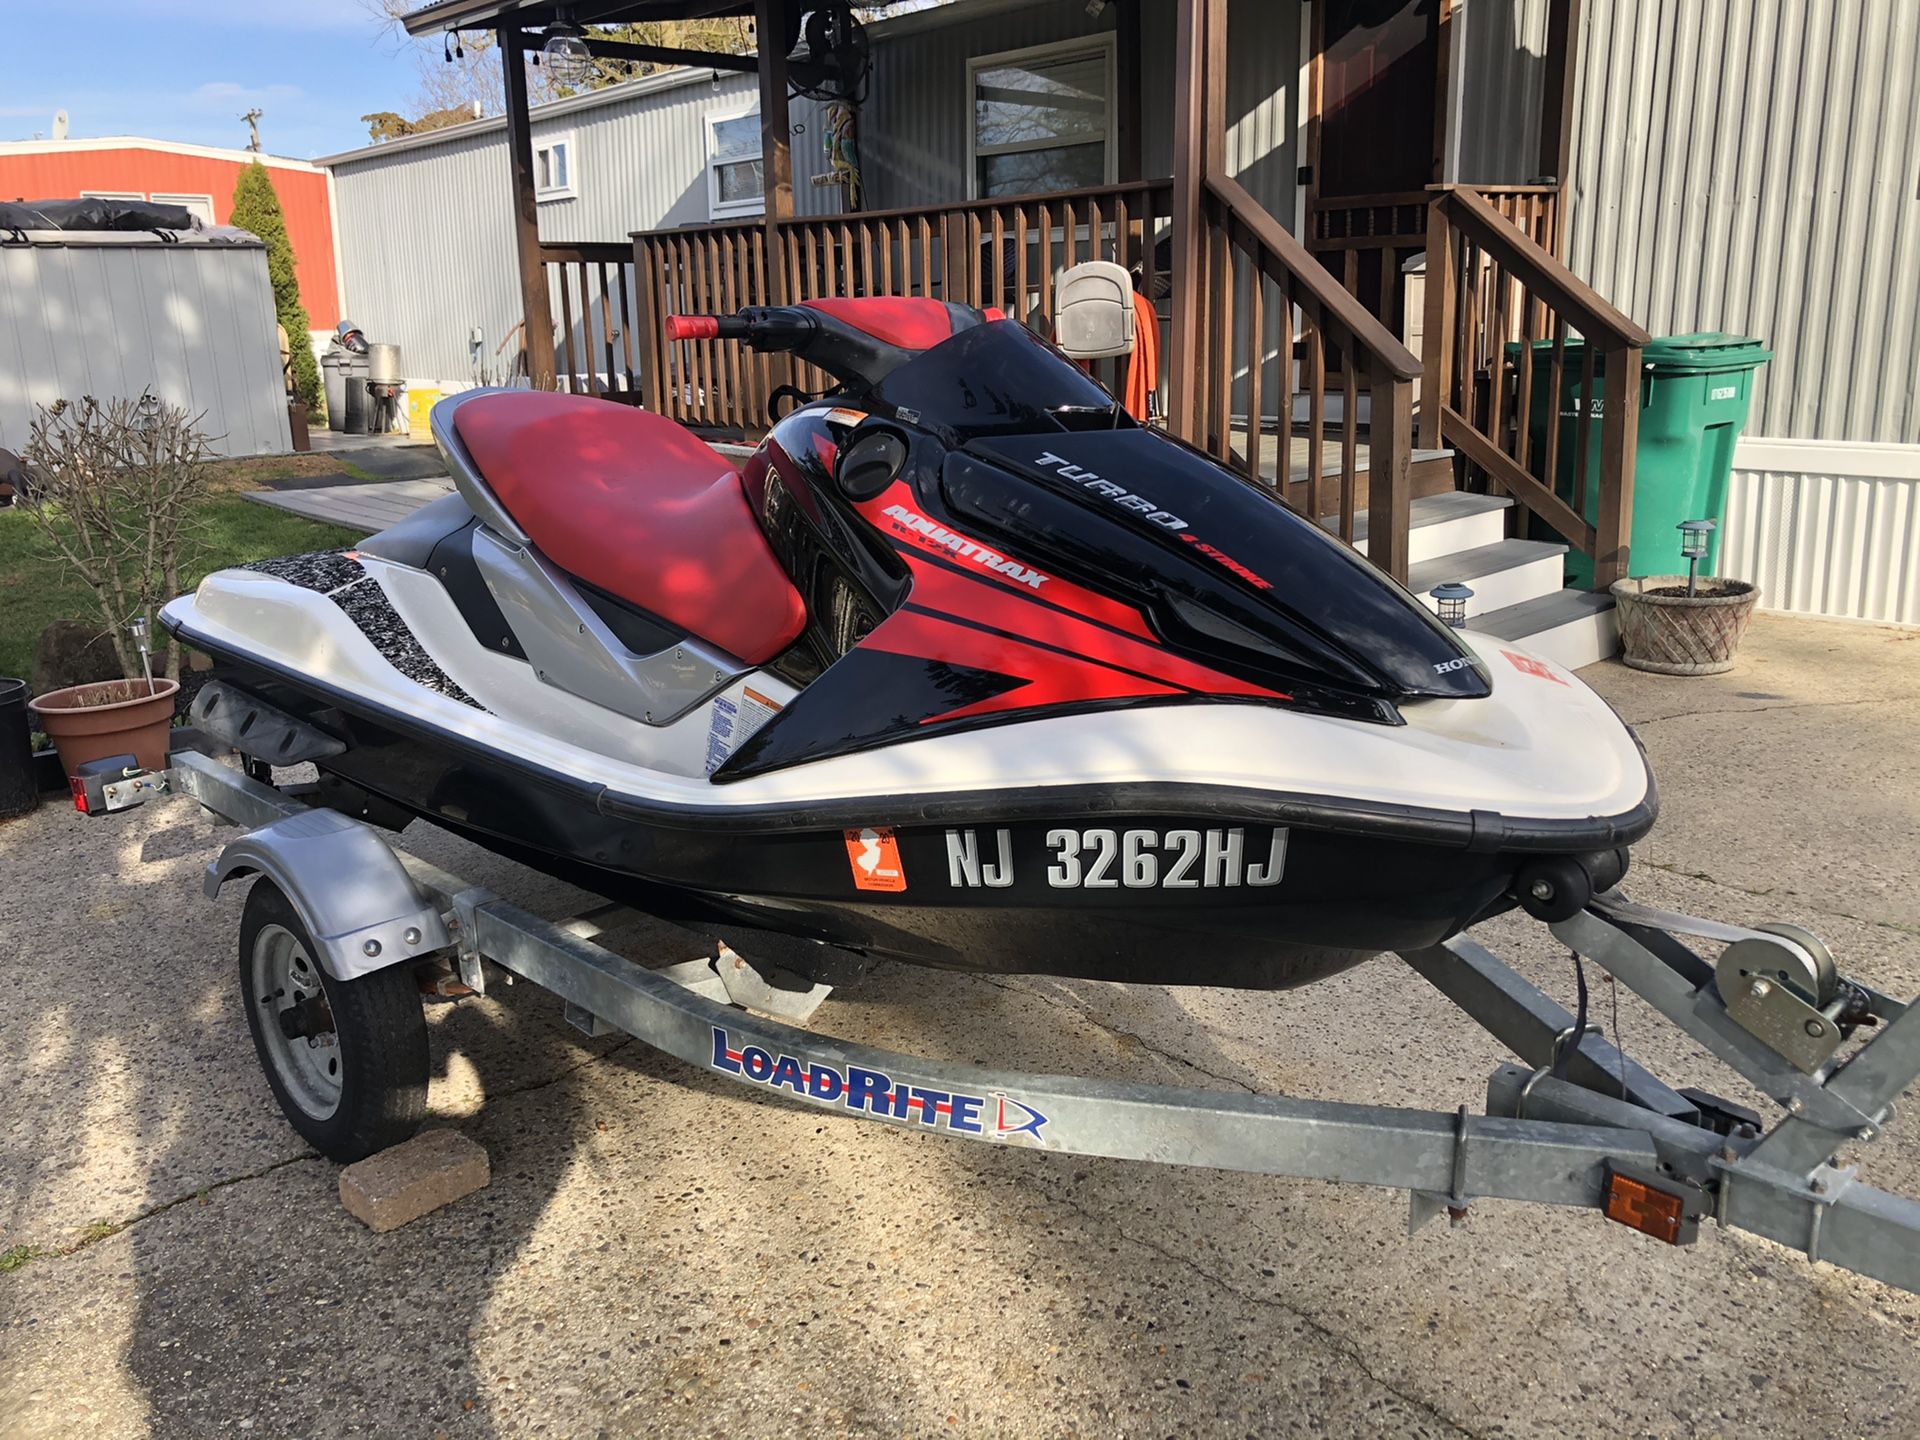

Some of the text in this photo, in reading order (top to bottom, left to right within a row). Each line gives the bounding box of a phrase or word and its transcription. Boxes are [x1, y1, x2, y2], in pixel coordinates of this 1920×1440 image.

[1034, 451, 1189, 530] TURBO
[882, 504, 1050, 589] AQUATRAX
[1195, 543, 1274, 589] STROKE
[1433, 657, 1473, 674] HON
[945, 827, 1290, 888] NJ 3262HJ
